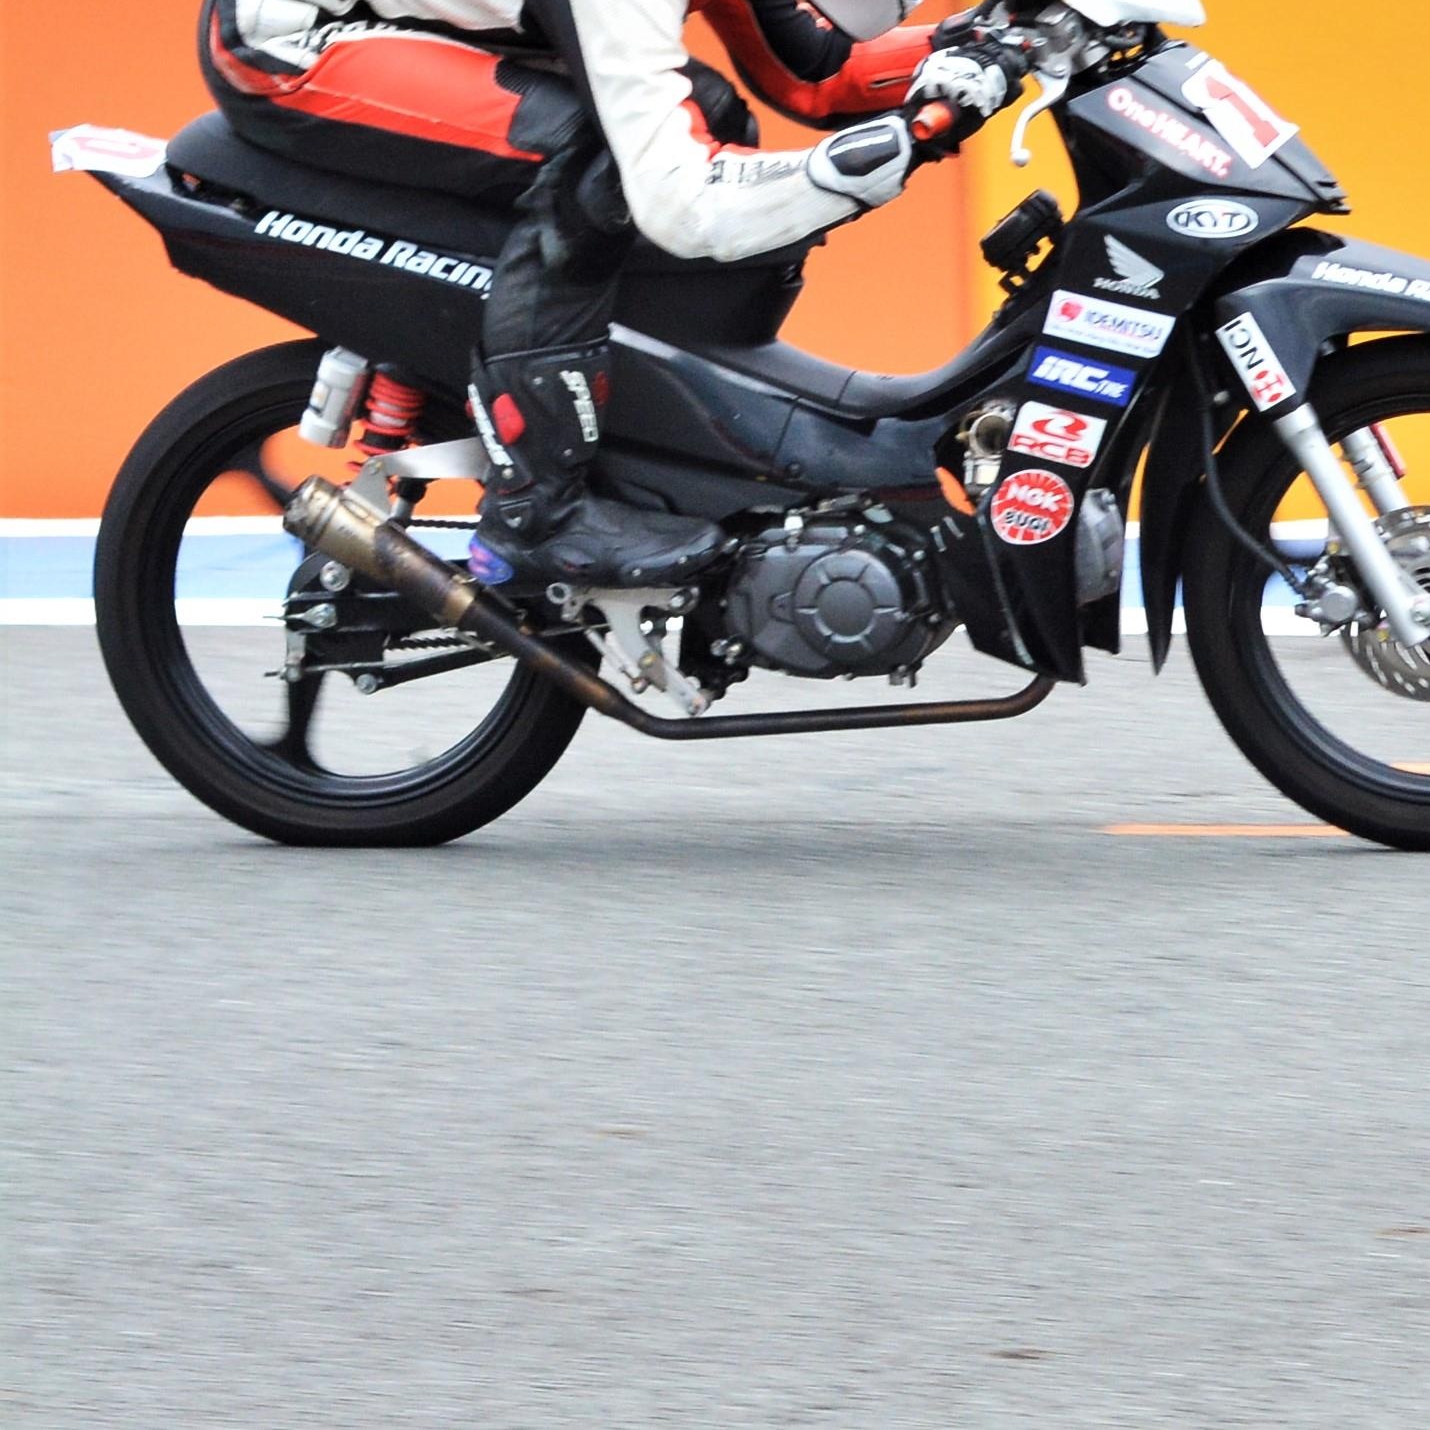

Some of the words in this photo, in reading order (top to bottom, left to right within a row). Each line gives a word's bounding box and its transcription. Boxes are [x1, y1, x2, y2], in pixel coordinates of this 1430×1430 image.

[1204, 75, 1281, 148] 1
[254, 210, 385, 261] Honda
[1312, 261, 1408, 294] Honda
[1225, 318, 1265, 371] NCI
[1011, 433, 1090, 464] RCB
[1005, 483, 1064, 512] NGK
